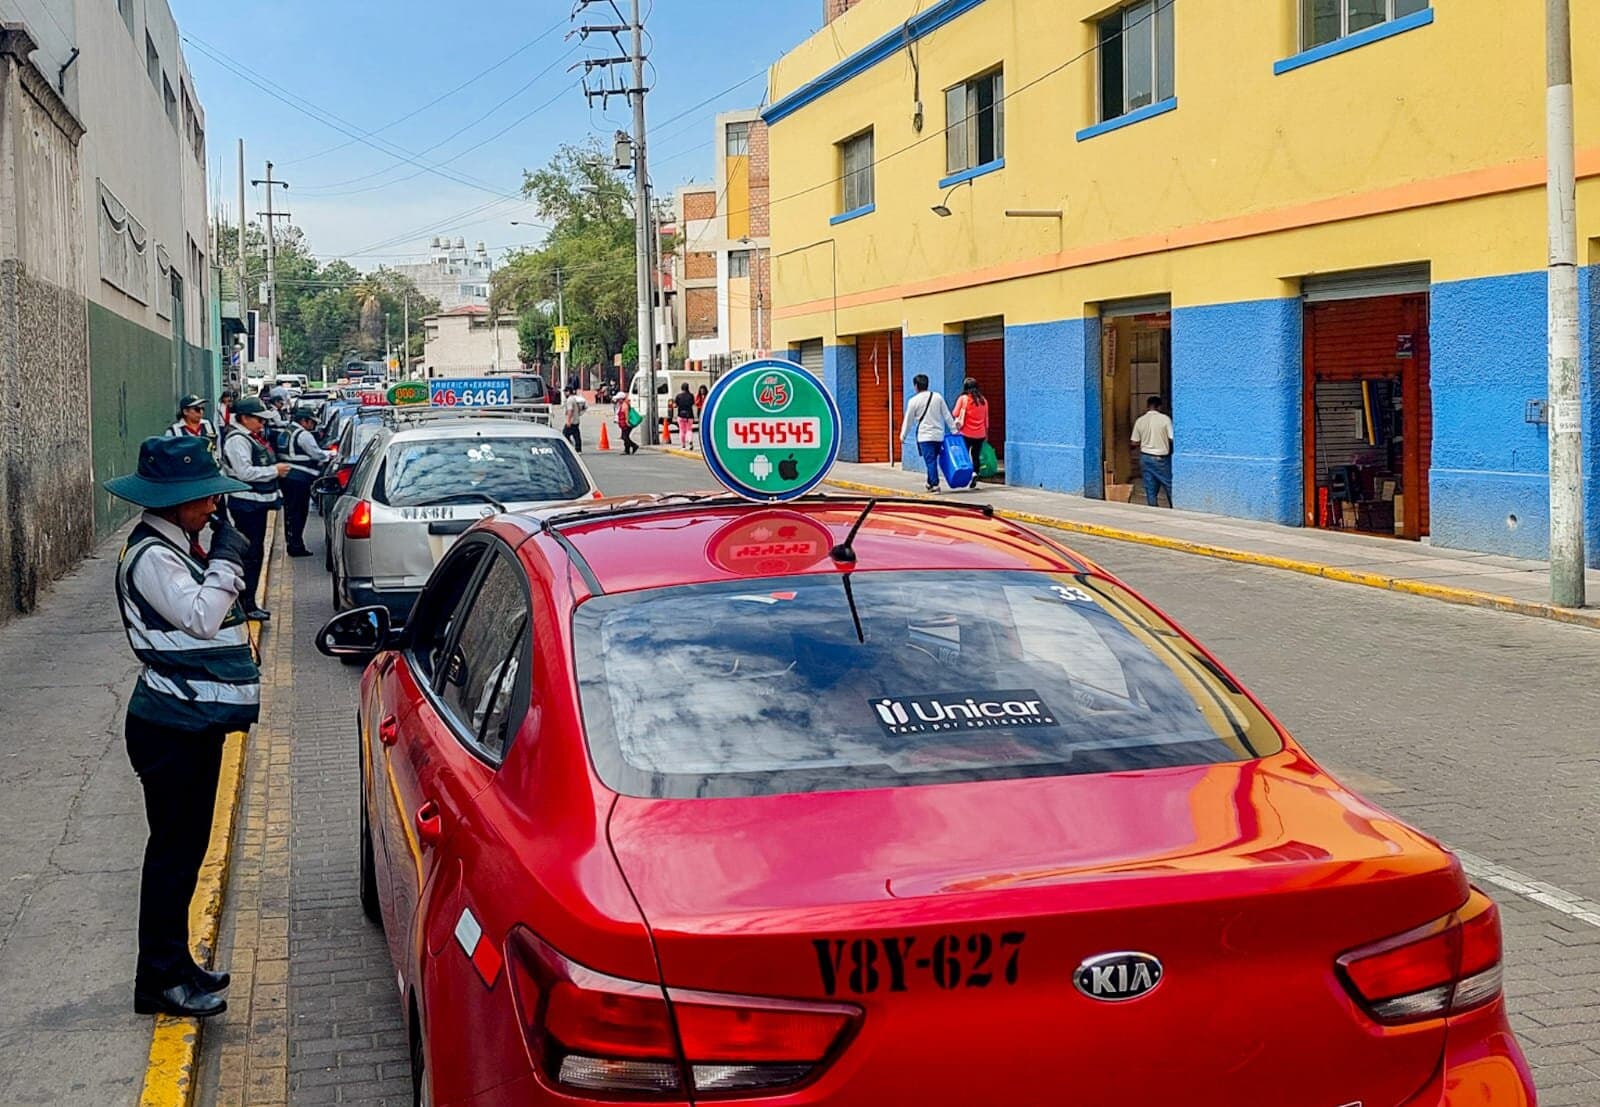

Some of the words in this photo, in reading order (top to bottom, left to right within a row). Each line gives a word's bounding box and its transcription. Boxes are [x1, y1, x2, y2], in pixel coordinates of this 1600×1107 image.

[473, 381, 506, 389] EXPRESS
[759, 383, 788, 407] 45
[432, 389, 509, 407] 46-6464
[733, 421, 814, 444] 454545
[1050, 585, 1093, 602] 33
[911, 698, 1041, 722] Unicar
[811, 931, 1026, 996] V8Y-627
[1091, 963, 1153, 995] KIA
